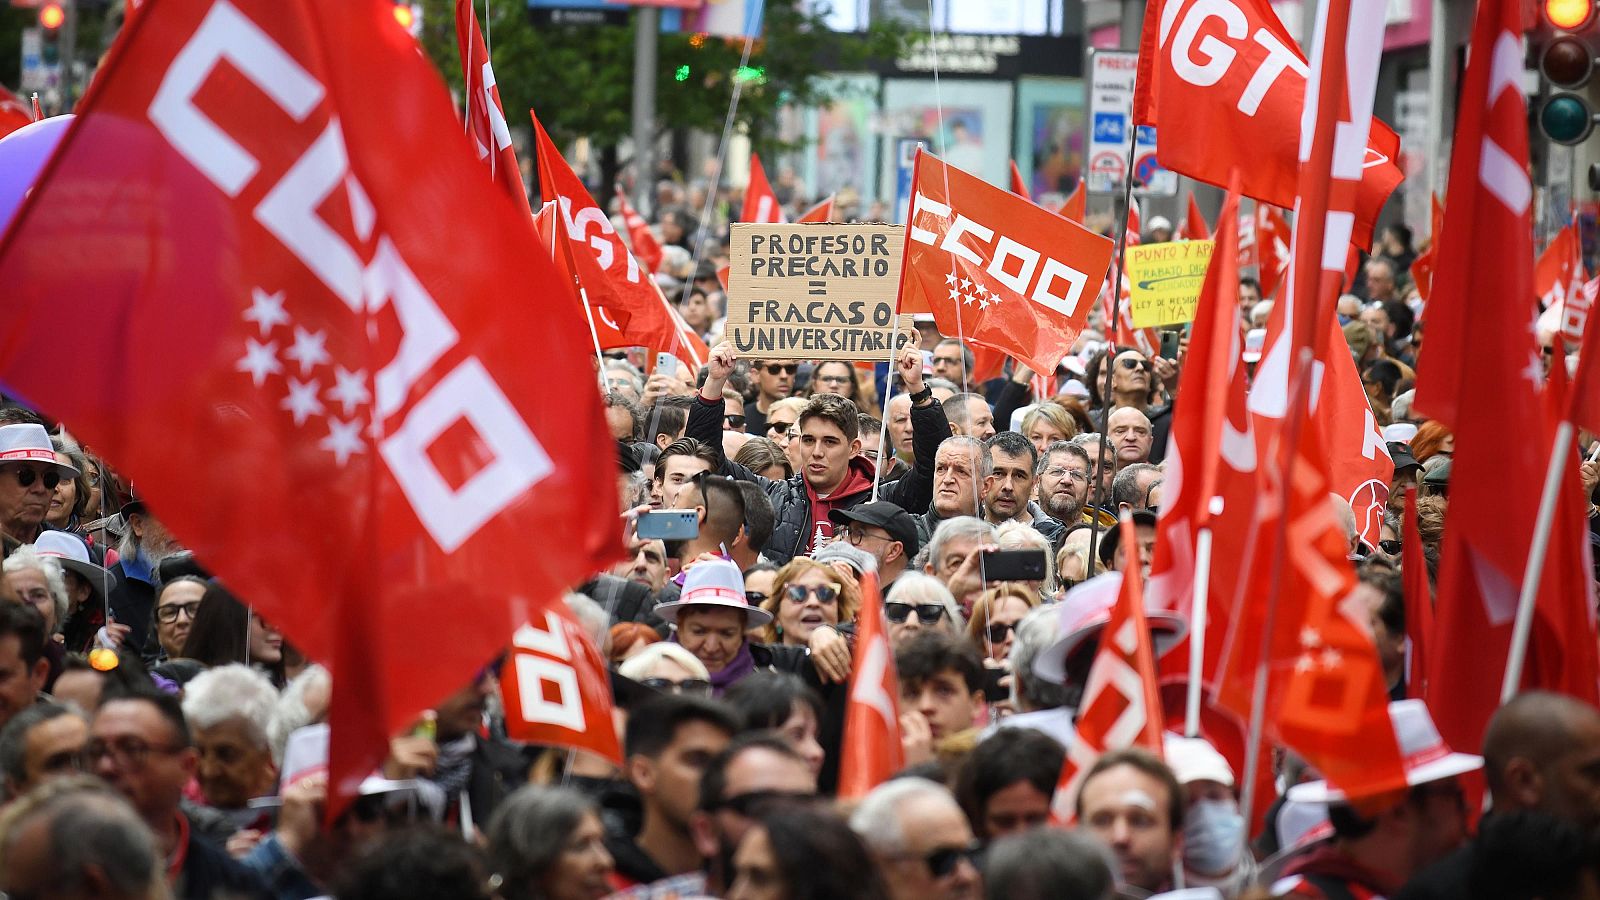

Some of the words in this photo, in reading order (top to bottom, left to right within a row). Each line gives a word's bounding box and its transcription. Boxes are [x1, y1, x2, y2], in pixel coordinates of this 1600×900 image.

[751, 233, 890, 256] PROFESOR
[911, 191, 1089, 318] CCOO
[1134, 246, 1177, 262] PUNTO
[1183, 244, 1191, 257] Y
[750, 256, 889, 278] PRECARIO
[1136, 266, 1182, 280] TRABAJO
[808, 280, 827, 295] =
[1136, 301, 1152, 310] LEY
[1156, 298, 1165, 307] DE
[734, 327, 909, 352] UNIVERSITARIO
